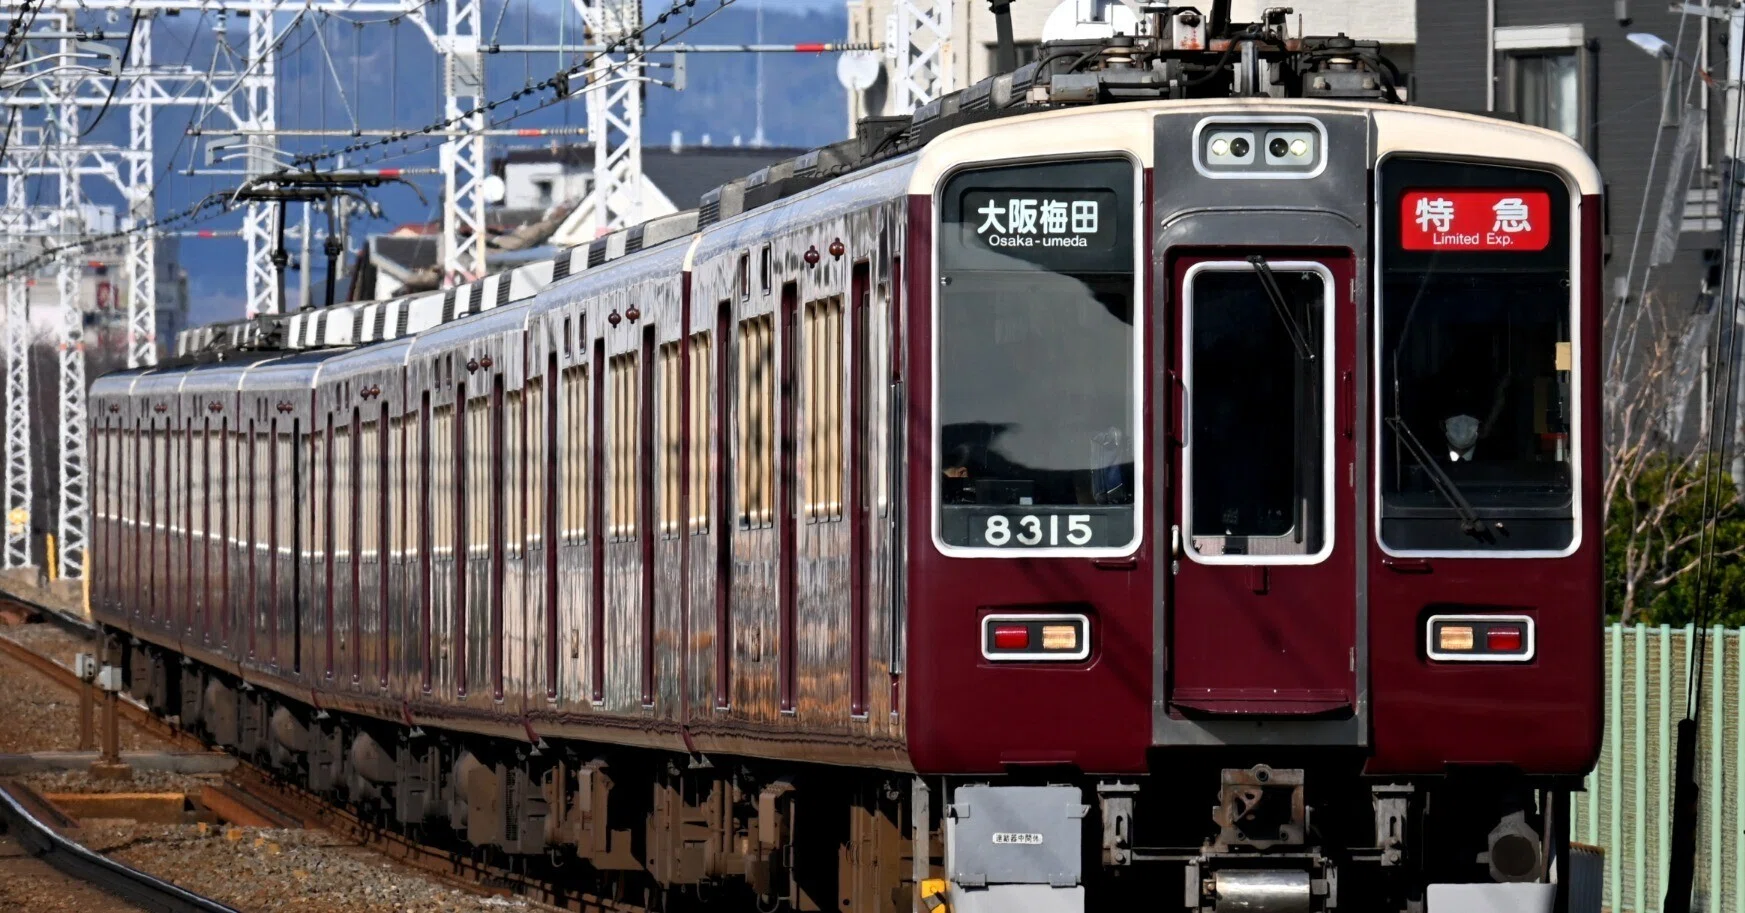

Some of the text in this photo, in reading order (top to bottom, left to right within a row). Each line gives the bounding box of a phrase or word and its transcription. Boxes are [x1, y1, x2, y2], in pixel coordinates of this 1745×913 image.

[977, 199, 1098, 234] 大阪梅田
[989, 235, 1087, 247] Osaka-umeda
[1433, 233, 1514, 246] Limited Exp.
[985, 515, 1092, 546] 8315
